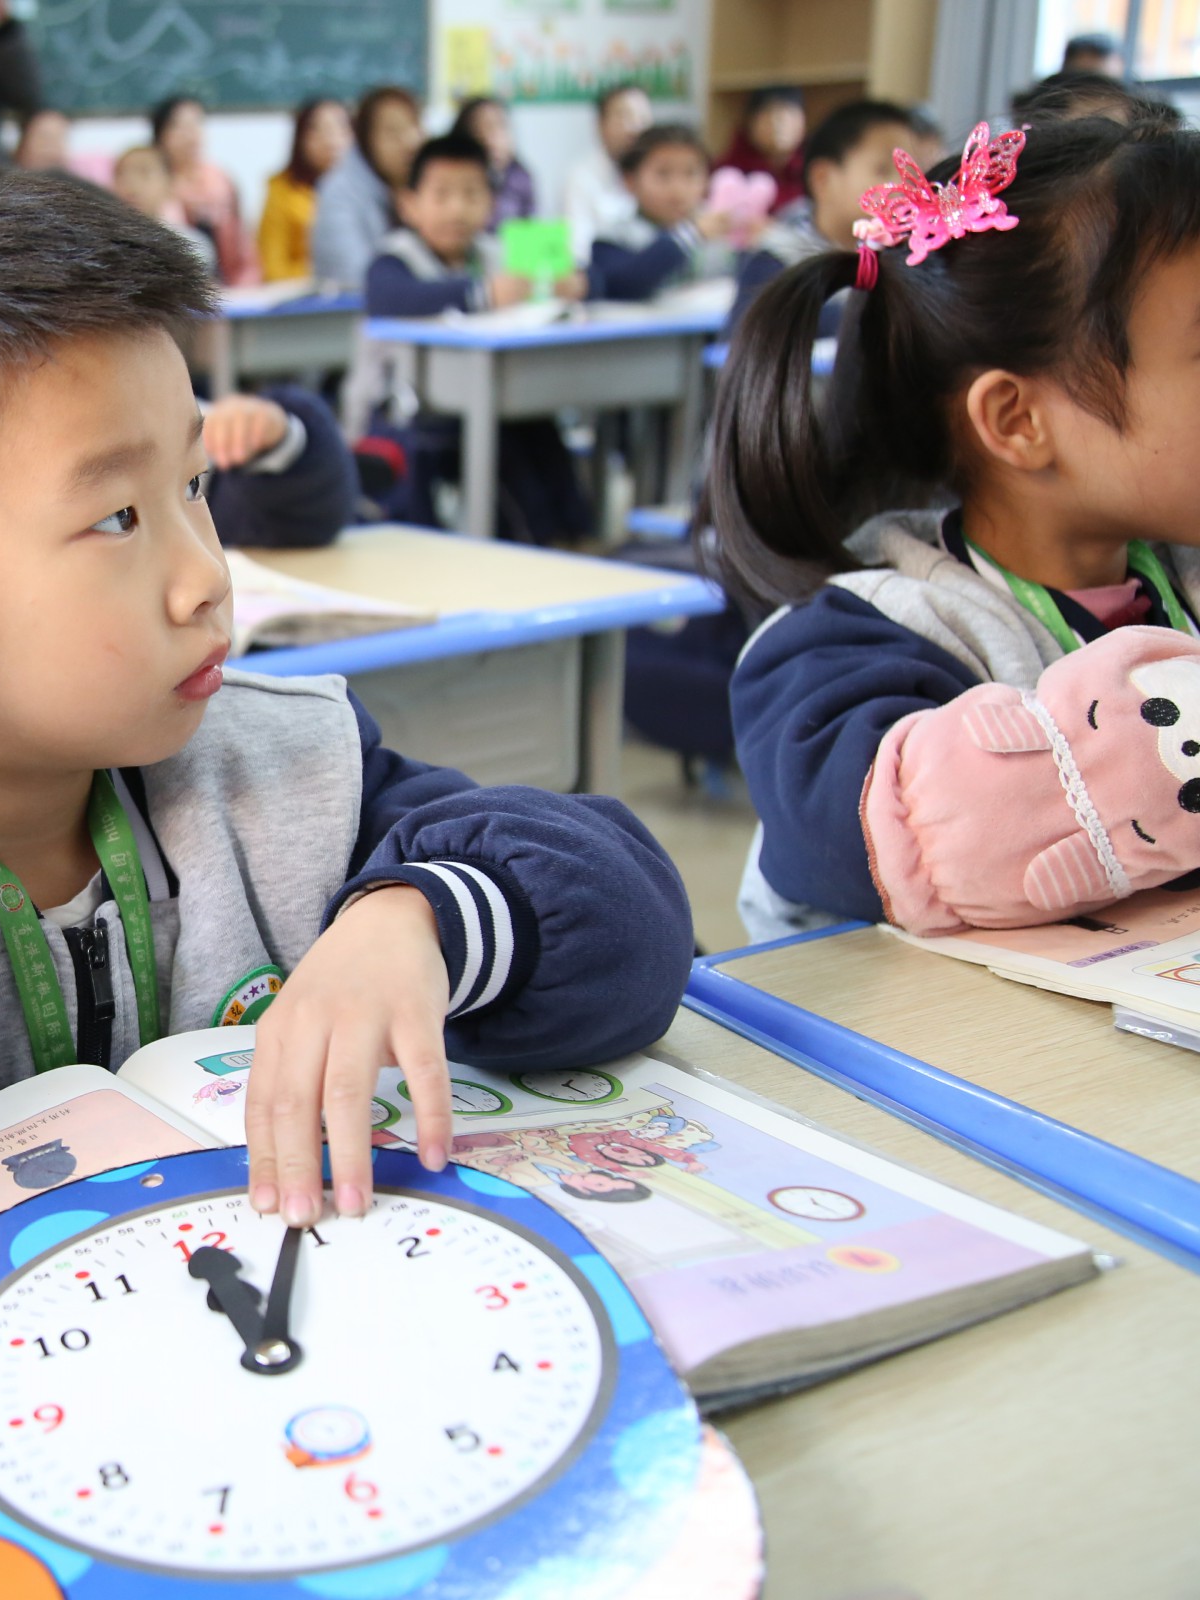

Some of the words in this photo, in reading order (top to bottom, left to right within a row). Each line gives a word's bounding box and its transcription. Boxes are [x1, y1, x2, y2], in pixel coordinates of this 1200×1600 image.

[171, 1210, 189, 1220] 60
[198, 1204, 215, 1214] 01
[225, 1200, 243, 1209] 02
[391, 1203, 408, 1213] 08
[413, 1208, 430, 1217] 09
[117, 1227, 135, 1236] 58
[144, 1217, 161, 1226] 59
[94, 1236, 110, 1245] 57
[173, 1231, 235, 1263] 12
[306, 1225, 331, 1248] 1
[397, 1236, 431, 1258] 2
[74, 1247, 92, 1256] 56
[84, 1274, 138, 1302] 11
[474, 1284, 510, 1312] 3
[33, 1328, 91, 1358] 10
[493, 1352, 520, 1373] 4
[32, 1402, 66, 1434] 9
[443, 1420, 481, 1454] 5
[98, 1461, 130, 1490] 8
[344, 1470, 379, 1503] 6
[201, 1484, 232, 1515] 7
